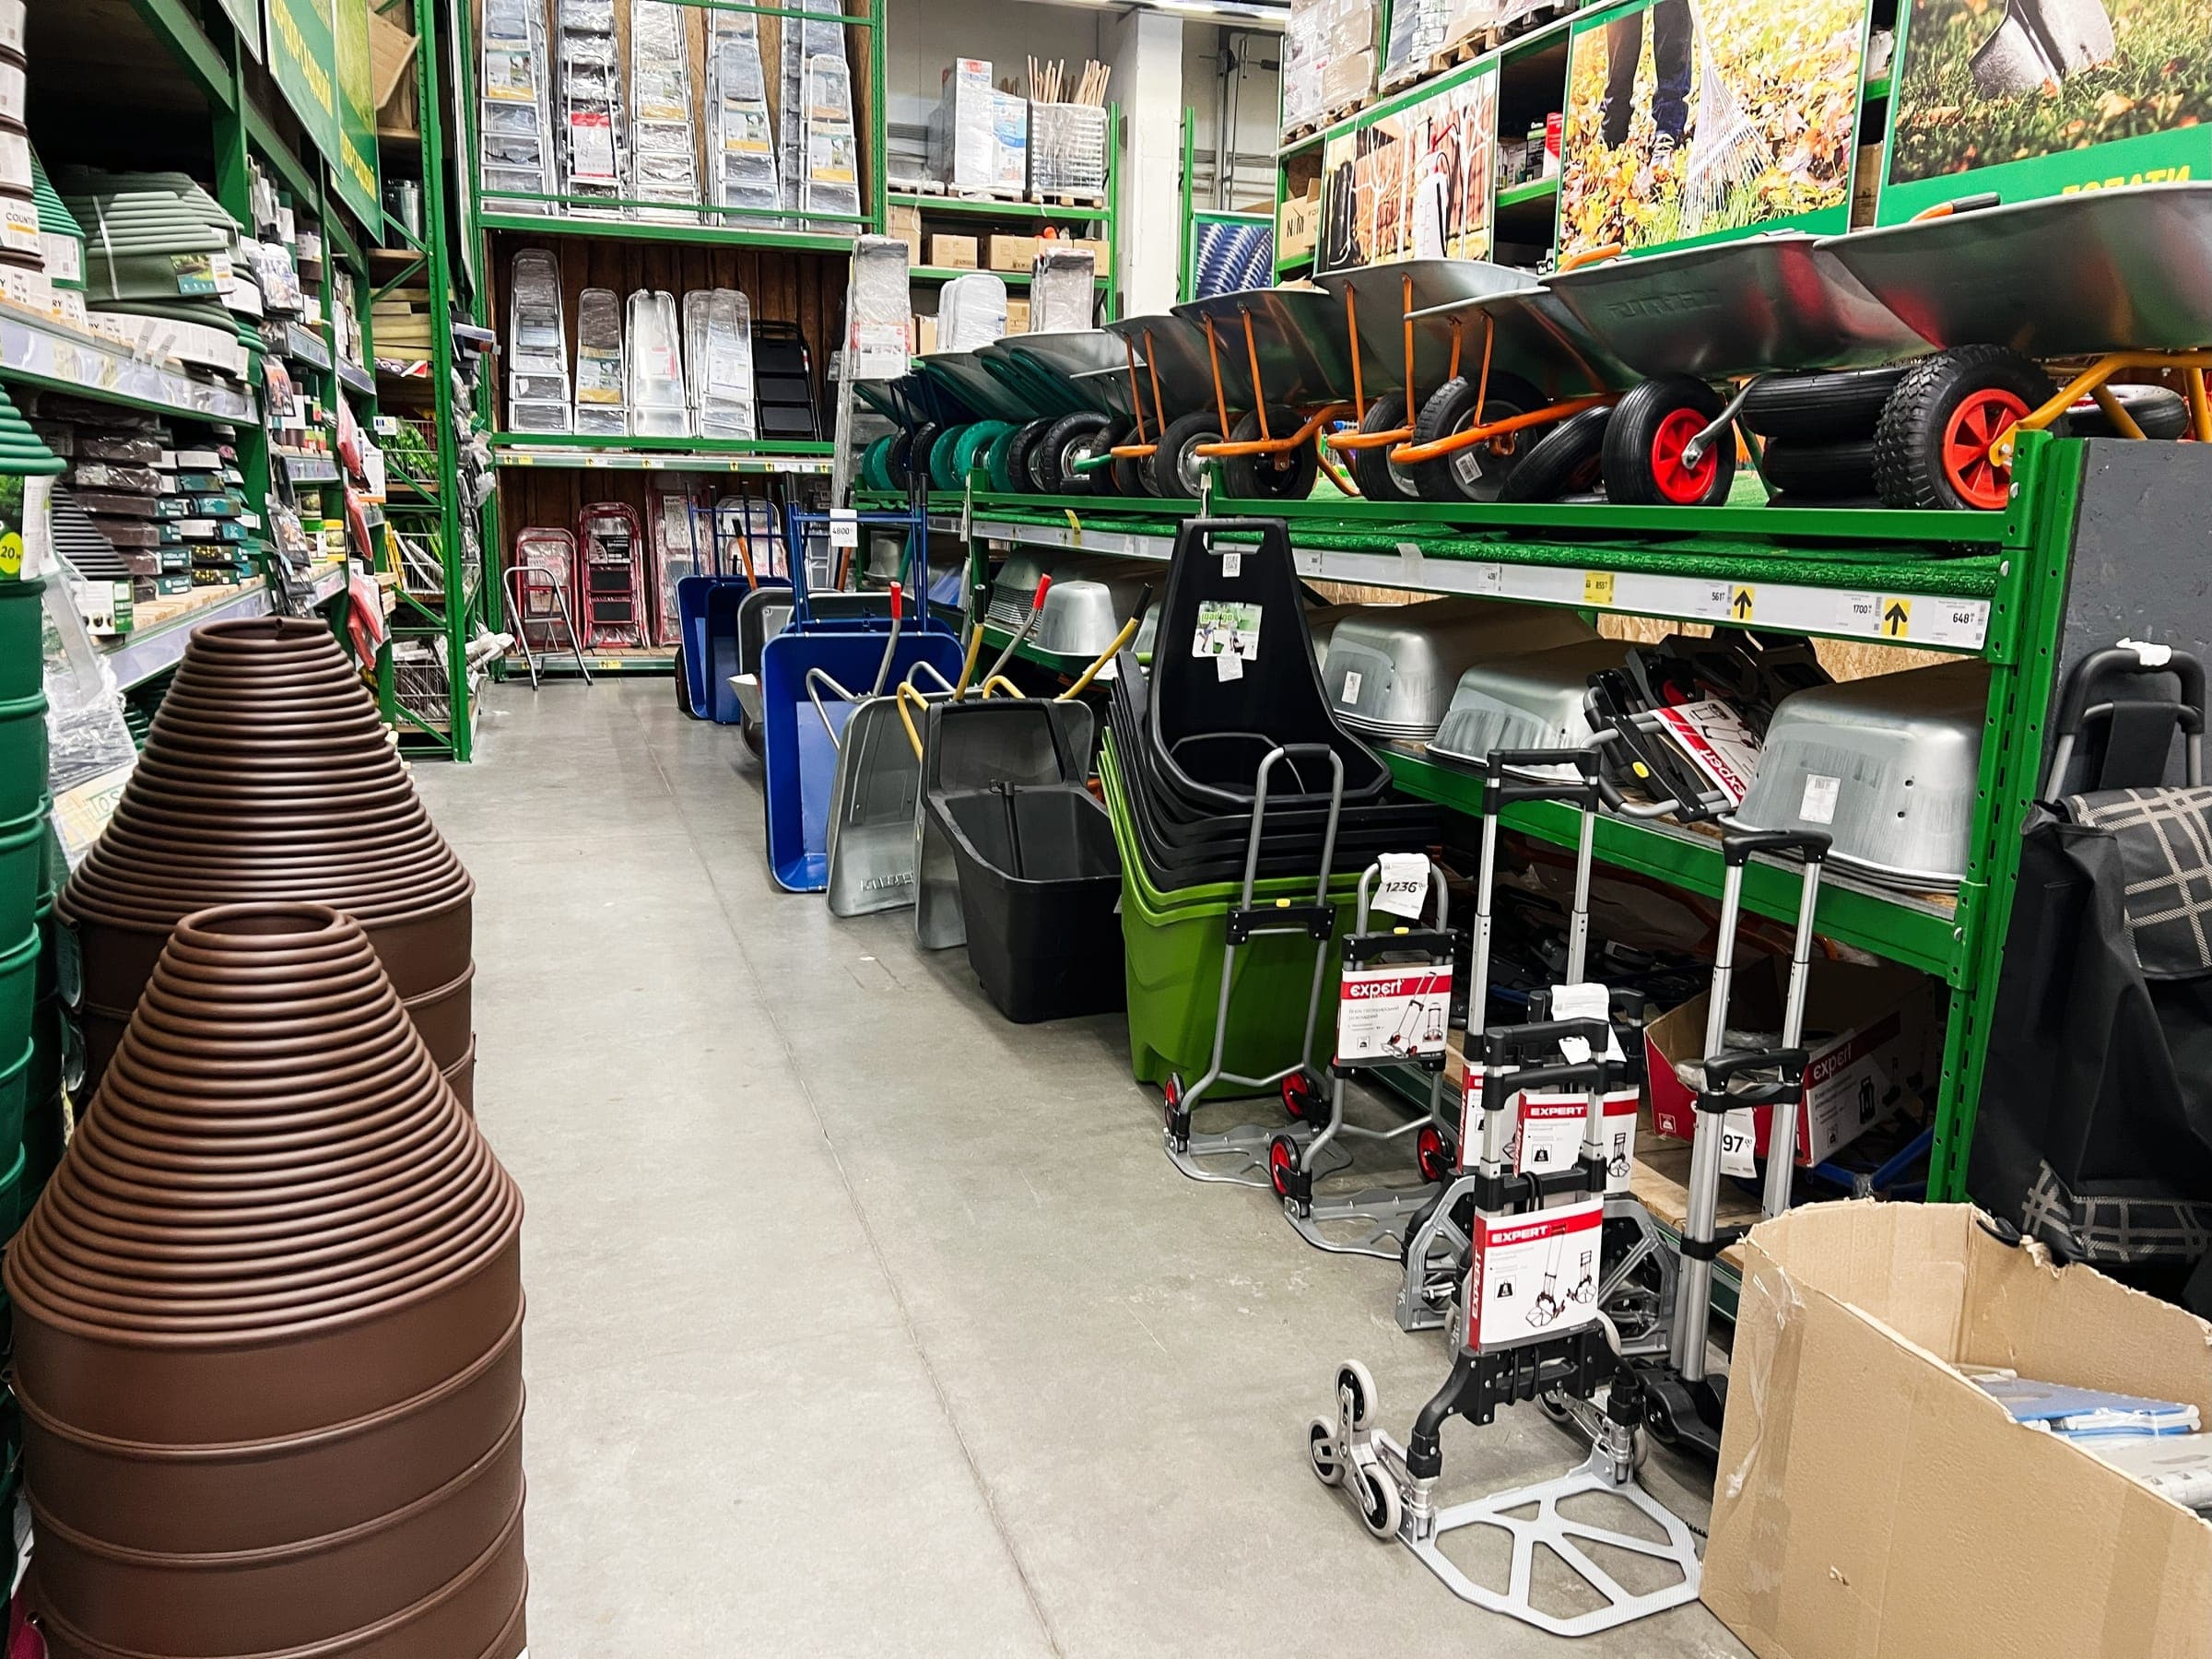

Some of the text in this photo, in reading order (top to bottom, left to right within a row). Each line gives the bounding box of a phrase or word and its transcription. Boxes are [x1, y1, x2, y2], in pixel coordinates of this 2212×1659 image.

[1952, 612, 1970, 624] 648
[1385, 881, 1418, 893] 1236
[1349, 978, 1403, 1000] expert
[1813, 1042, 1852, 1080] expert
[1530, 1106, 1584, 1116] EXPERT
[1491, 1225, 1548, 1244] EXPERT
[1472, 1248, 1482, 1320] EXPERT
